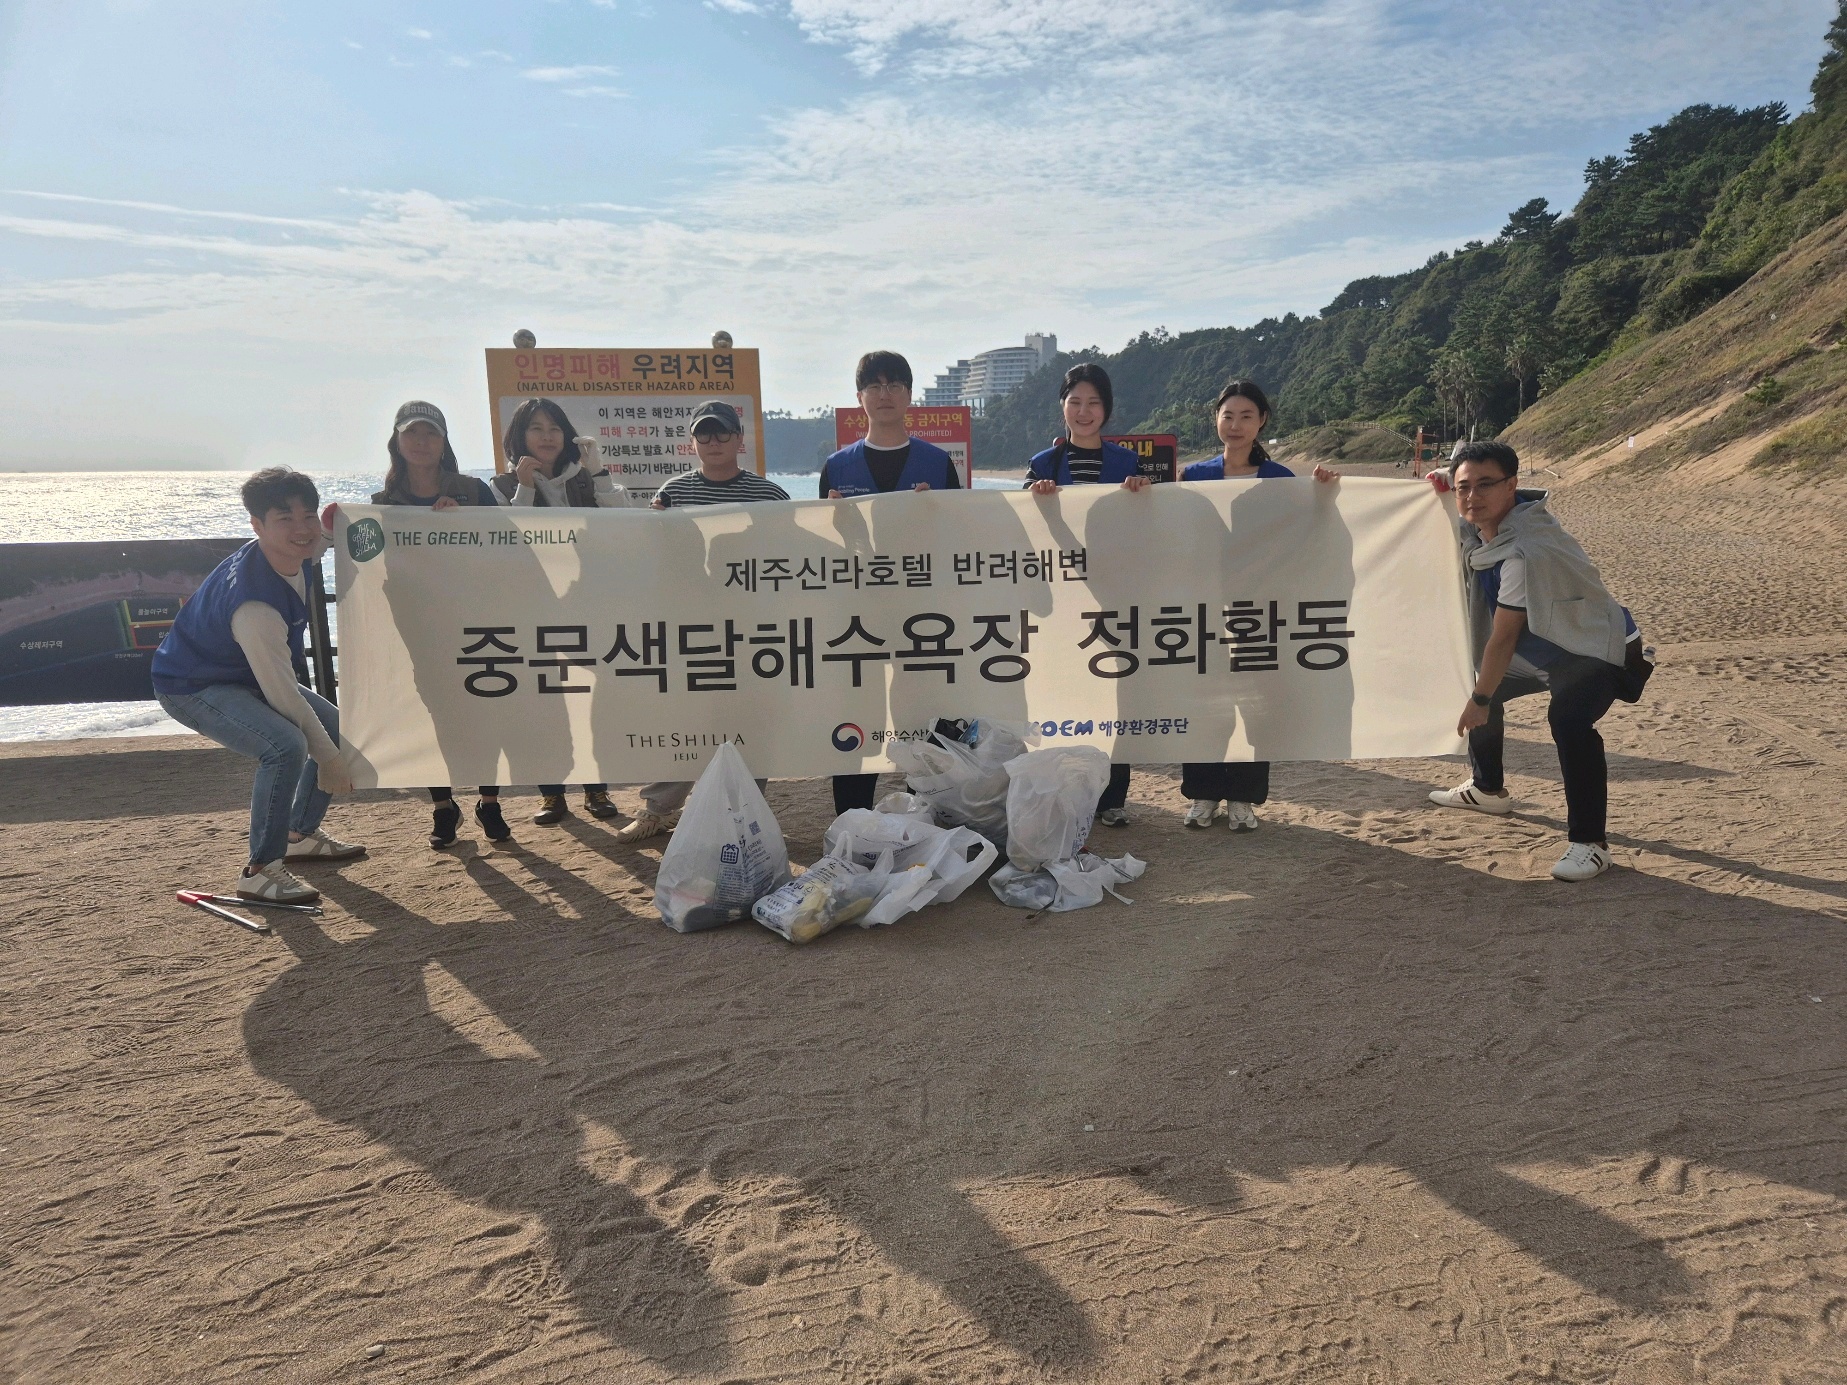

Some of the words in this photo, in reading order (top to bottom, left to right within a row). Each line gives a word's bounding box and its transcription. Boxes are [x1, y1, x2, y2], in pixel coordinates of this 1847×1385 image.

[514, 353, 620, 380] 인명피해
[632, 353, 734, 380] 우려지역
[517, 381, 578, 392] (NATURAL
[583, 380, 643, 392] DISASTER
[648, 380, 695, 391] HAZARD
[700, 380, 734, 391] AREA)
[598, 407, 608, 419] 이
[614, 406, 647, 419] 지역은
[918, 413, 963, 427] 금지구역
[600, 426, 622, 438] 피해
[626, 425, 659, 438] 우려가
[664, 425, 686, 437] 높은
[602, 444, 641, 457] 기상특보
[644, 444, 663, 456] 발효
[665, 444, 675, 455] 시
[676, 444, 696, 456] 안전
[654, 462, 693, 474] 바랍니다
[393, 531, 422, 546] THE
[427, 531, 483, 547] GREEN,
[488, 530, 518, 545] THE
[523, 529, 577, 545] SHILLA
[725, 552, 933, 592] 제주신라호텔
[953, 548, 1089, 585] 반려해변
[19, 640, 63, 650] 수상레저구역
[456, 610, 1039, 698] 중문색달해수욕장
[1077, 600, 1355, 679] 정화활동
[1025, 718, 1094, 737] KOEM
[1098, 717, 1189, 737] 해양환경공단
[871, 729, 930, 743] 해양수산
[674, 753, 698, 761] JEJU
